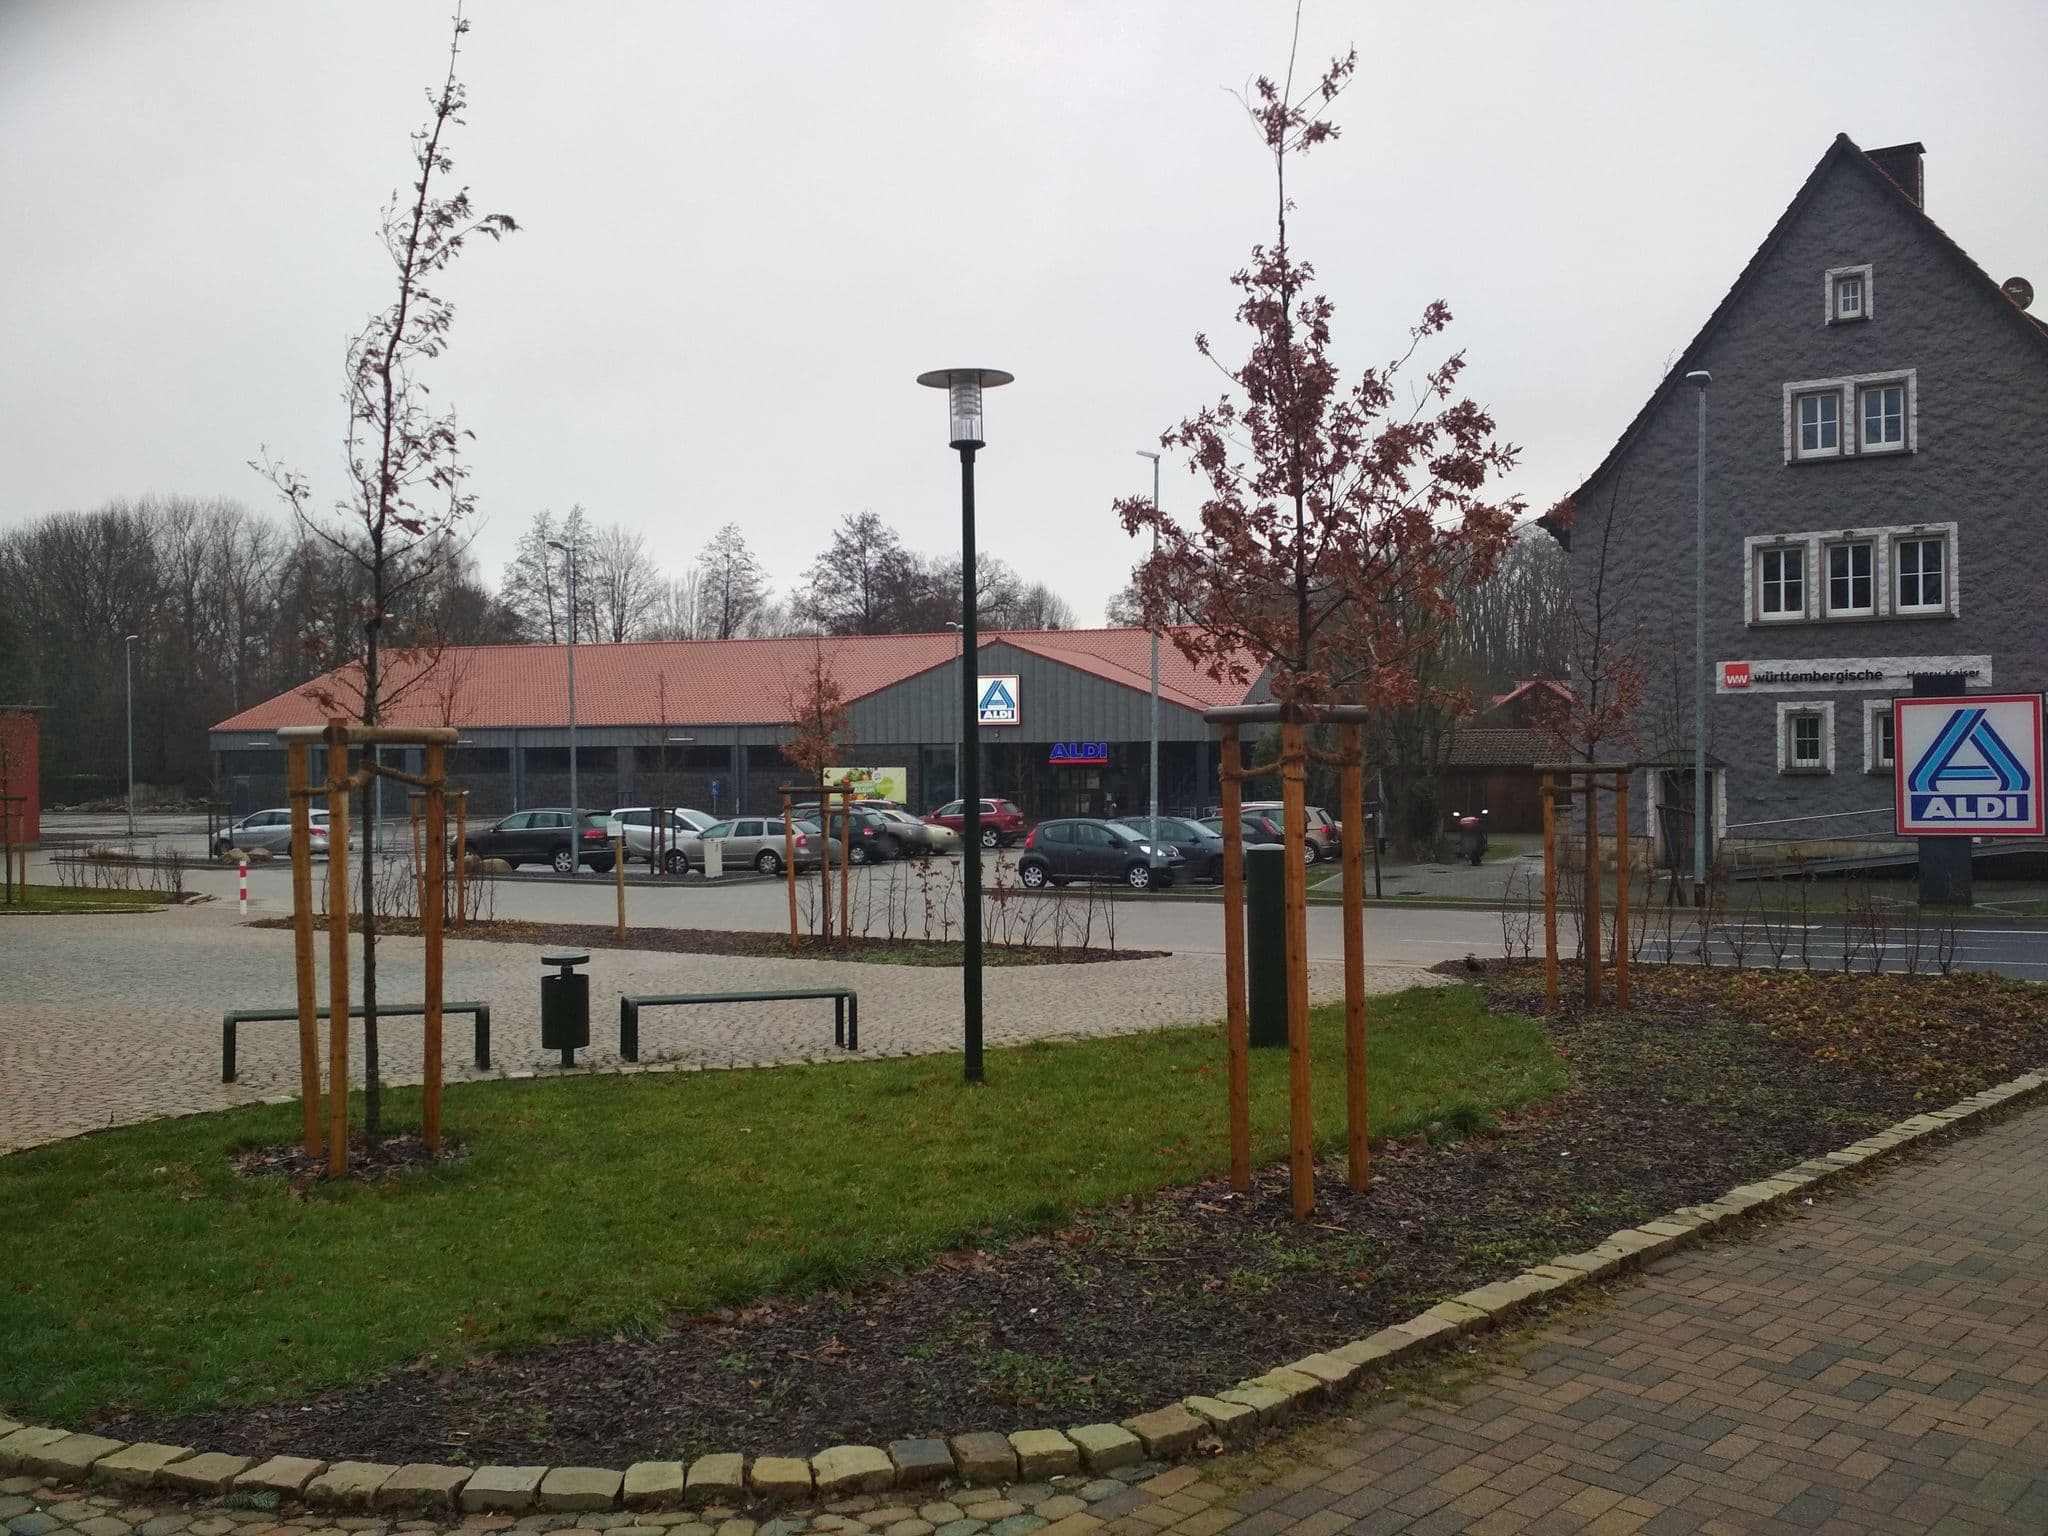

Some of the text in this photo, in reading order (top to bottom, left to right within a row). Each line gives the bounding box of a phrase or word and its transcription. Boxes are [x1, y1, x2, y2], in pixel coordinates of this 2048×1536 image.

[1755, 669, 1883, 684] württembergische
[983, 710, 1012, 719] ALDI
[1049, 742, 1108, 758] ALDI
[1922, 797, 2018, 819] ALDI
